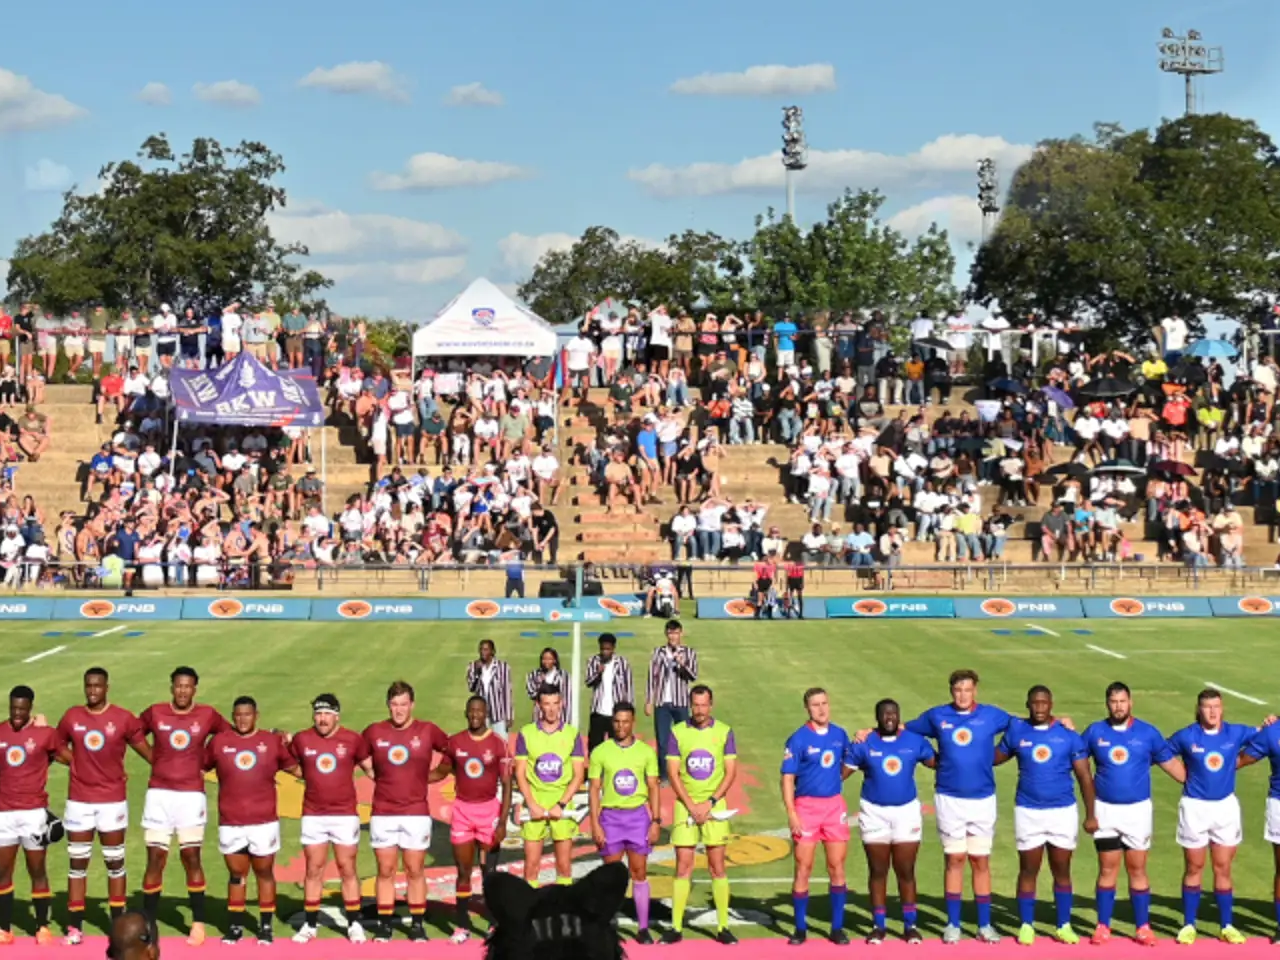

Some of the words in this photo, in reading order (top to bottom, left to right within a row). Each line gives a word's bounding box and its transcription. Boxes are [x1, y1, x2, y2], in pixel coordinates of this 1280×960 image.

[117, 603, 155, 613] FNB
[245, 603, 284, 613] FNB
[374, 604, 412, 613] FNB
[502, 603, 541, 612] FNB
[890, 603, 928, 612] FNB
[1018, 603, 1056, 612] FNB
[1147, 601, 1185, 611] FNB
